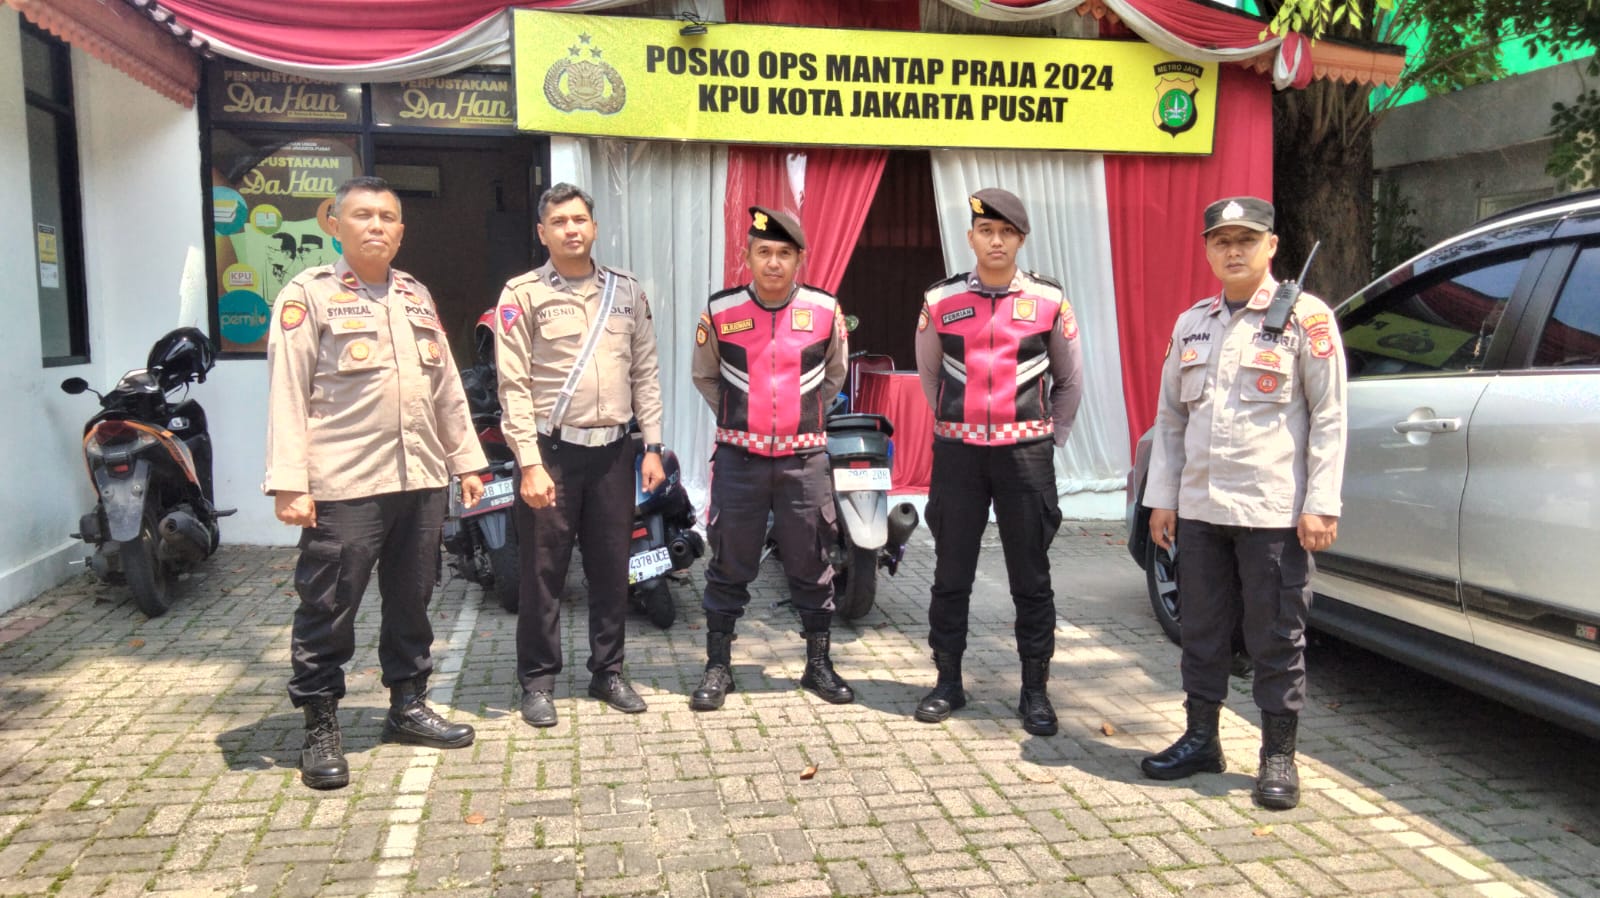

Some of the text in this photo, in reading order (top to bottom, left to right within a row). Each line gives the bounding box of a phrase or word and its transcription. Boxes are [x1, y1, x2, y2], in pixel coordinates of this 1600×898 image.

[646, 46, 1113, 91] POSKO OPS MANTAP PRAJA 2024
[1157, 64, 1200, 74] METRO JAYA
[224, 82, 340, 113] Da Han
[399, 88, 511, 119] Da Han
[699, 84, 1068, 123] KPU KOTA JAKARTA PUSAT
[239, 169, 337, 195] Da Han
[231, 272, 252, 280] KPU
[327, 305, 371, 317] SYAFRIZAL
[538, 307, 575, 319] WISNU
[1252, 332, 1297, 347] POLRI
